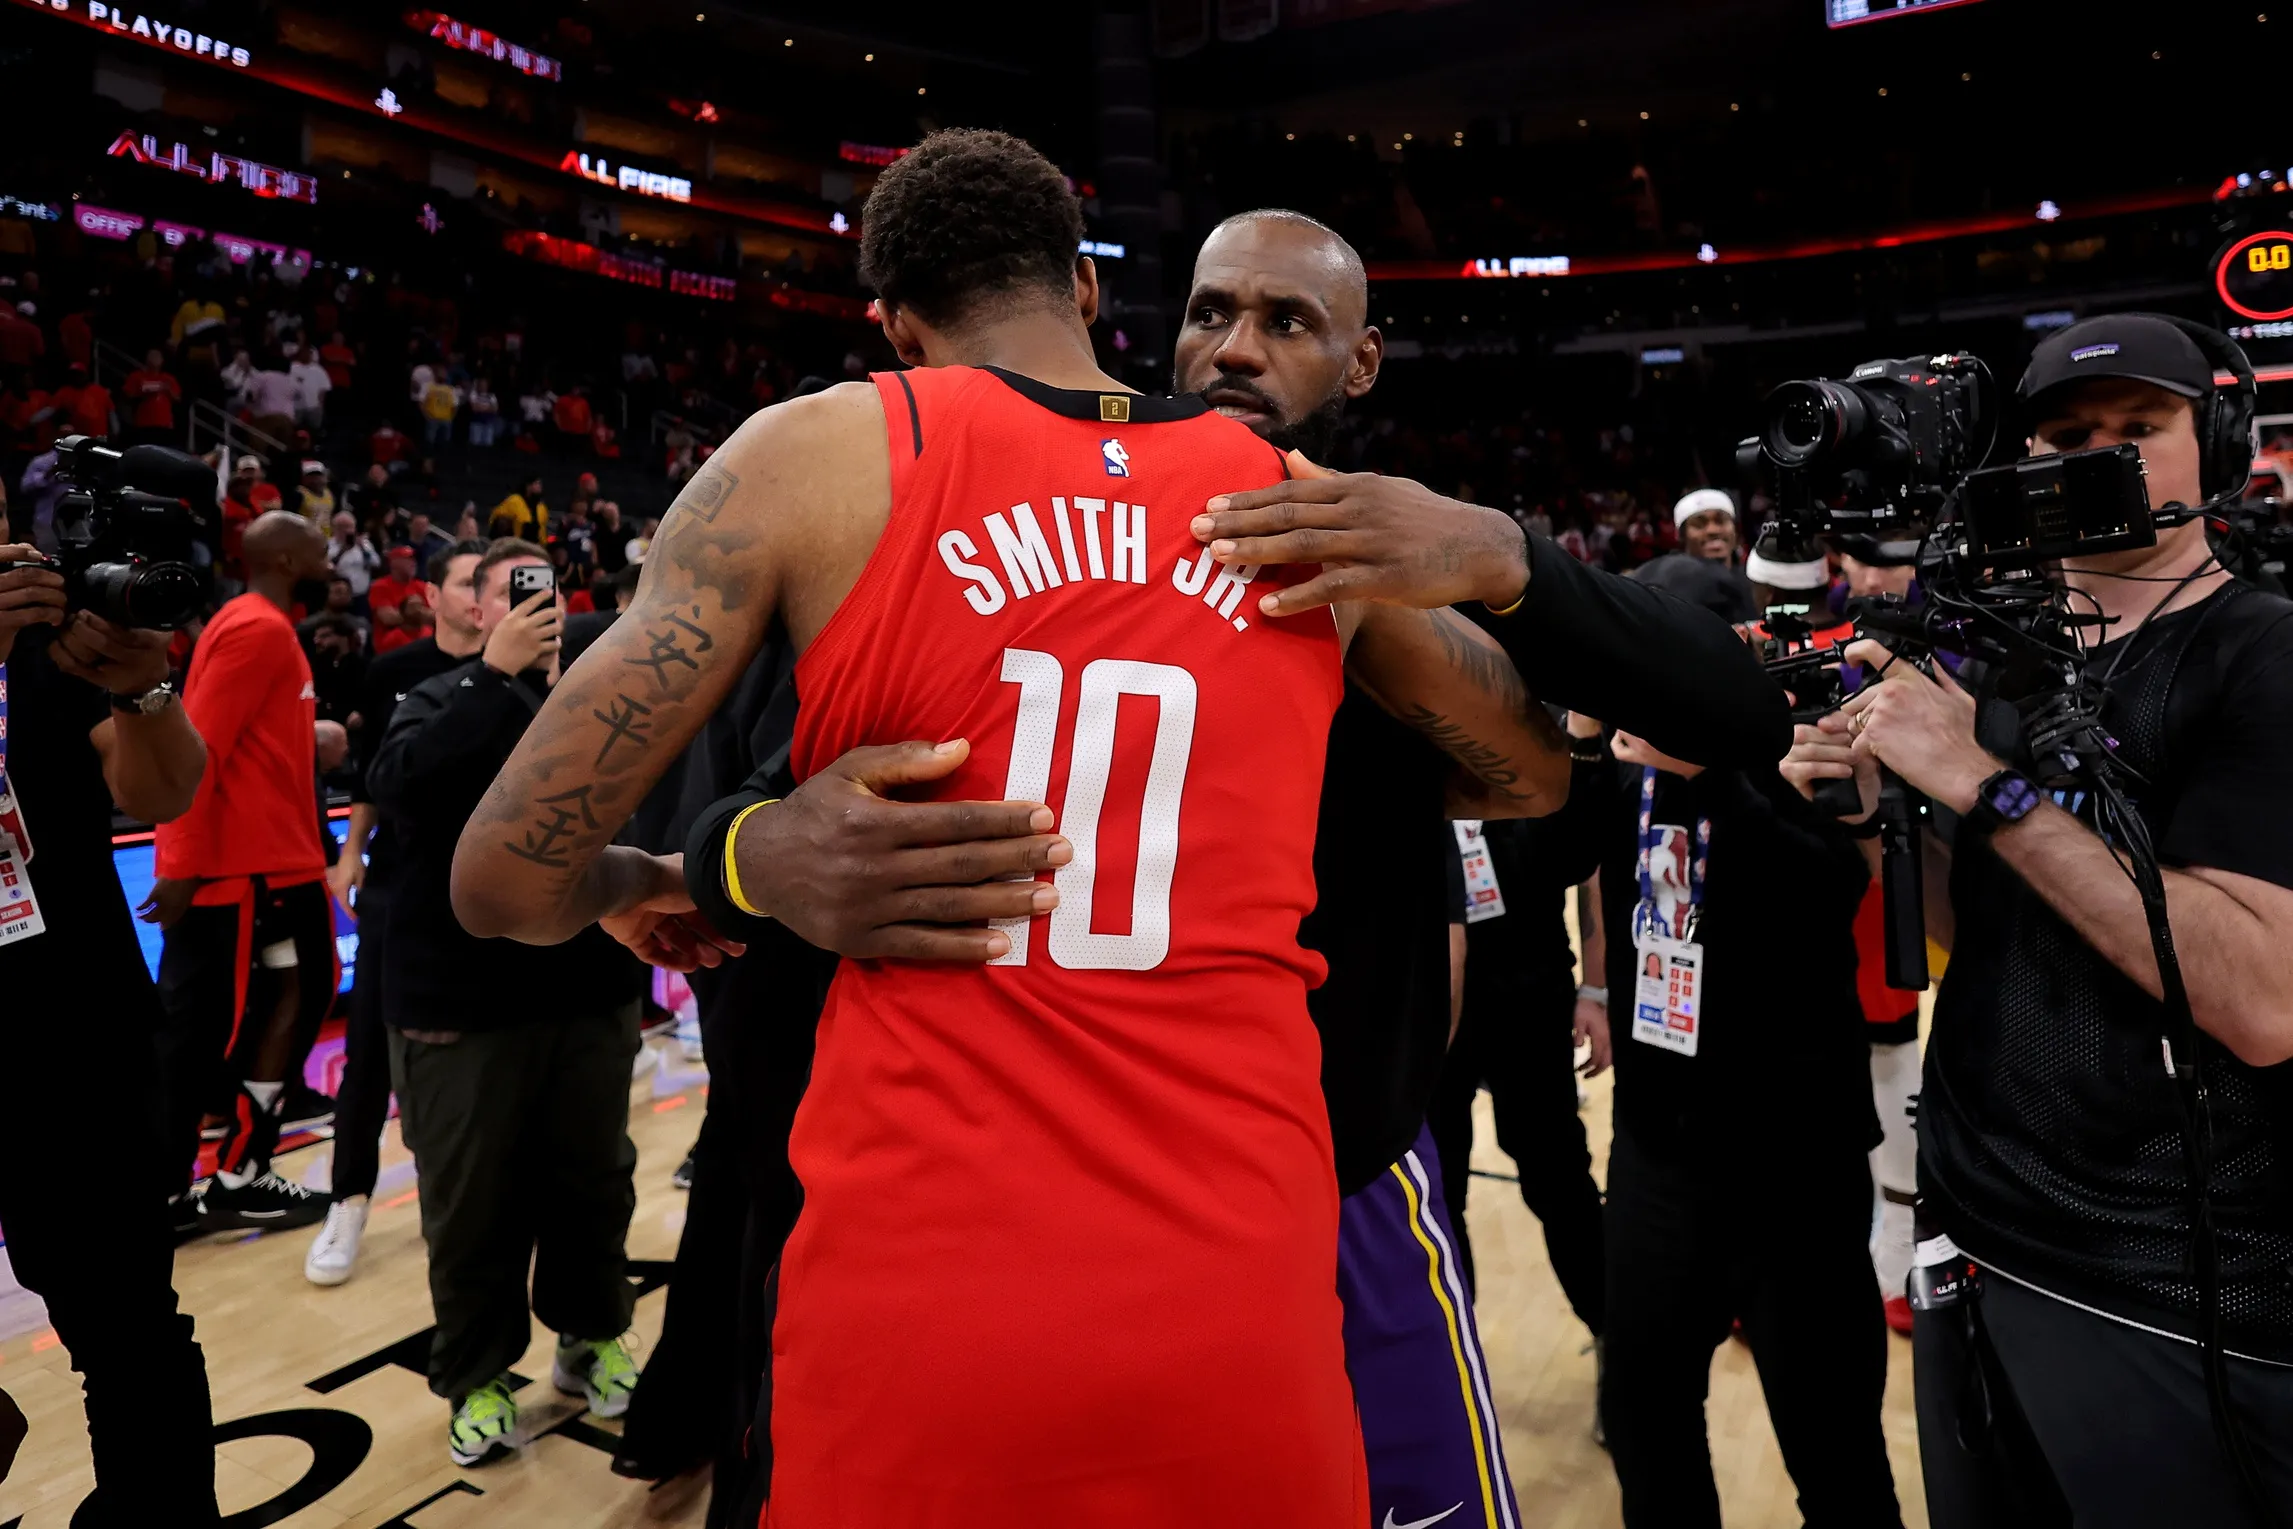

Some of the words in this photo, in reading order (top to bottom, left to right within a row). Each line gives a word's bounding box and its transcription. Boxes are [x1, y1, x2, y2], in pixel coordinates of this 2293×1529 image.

[88, 0, 251, 68] PLAYOFFS
[560, 150, 617, 186] ALL
[618, 165, 692, 204] FIRE
[1461, 258, 1509, 278] ALL
[2248, 244, 2291, 272] 0.0
[1111, 402, 1119, 416] 2
[1108, 465, 1123, 475] NBA
[936, 496, 1148, 617] SMITH
[1171, 540, 1262, 633] JR.
[986, 647, 1198, 971] 10
